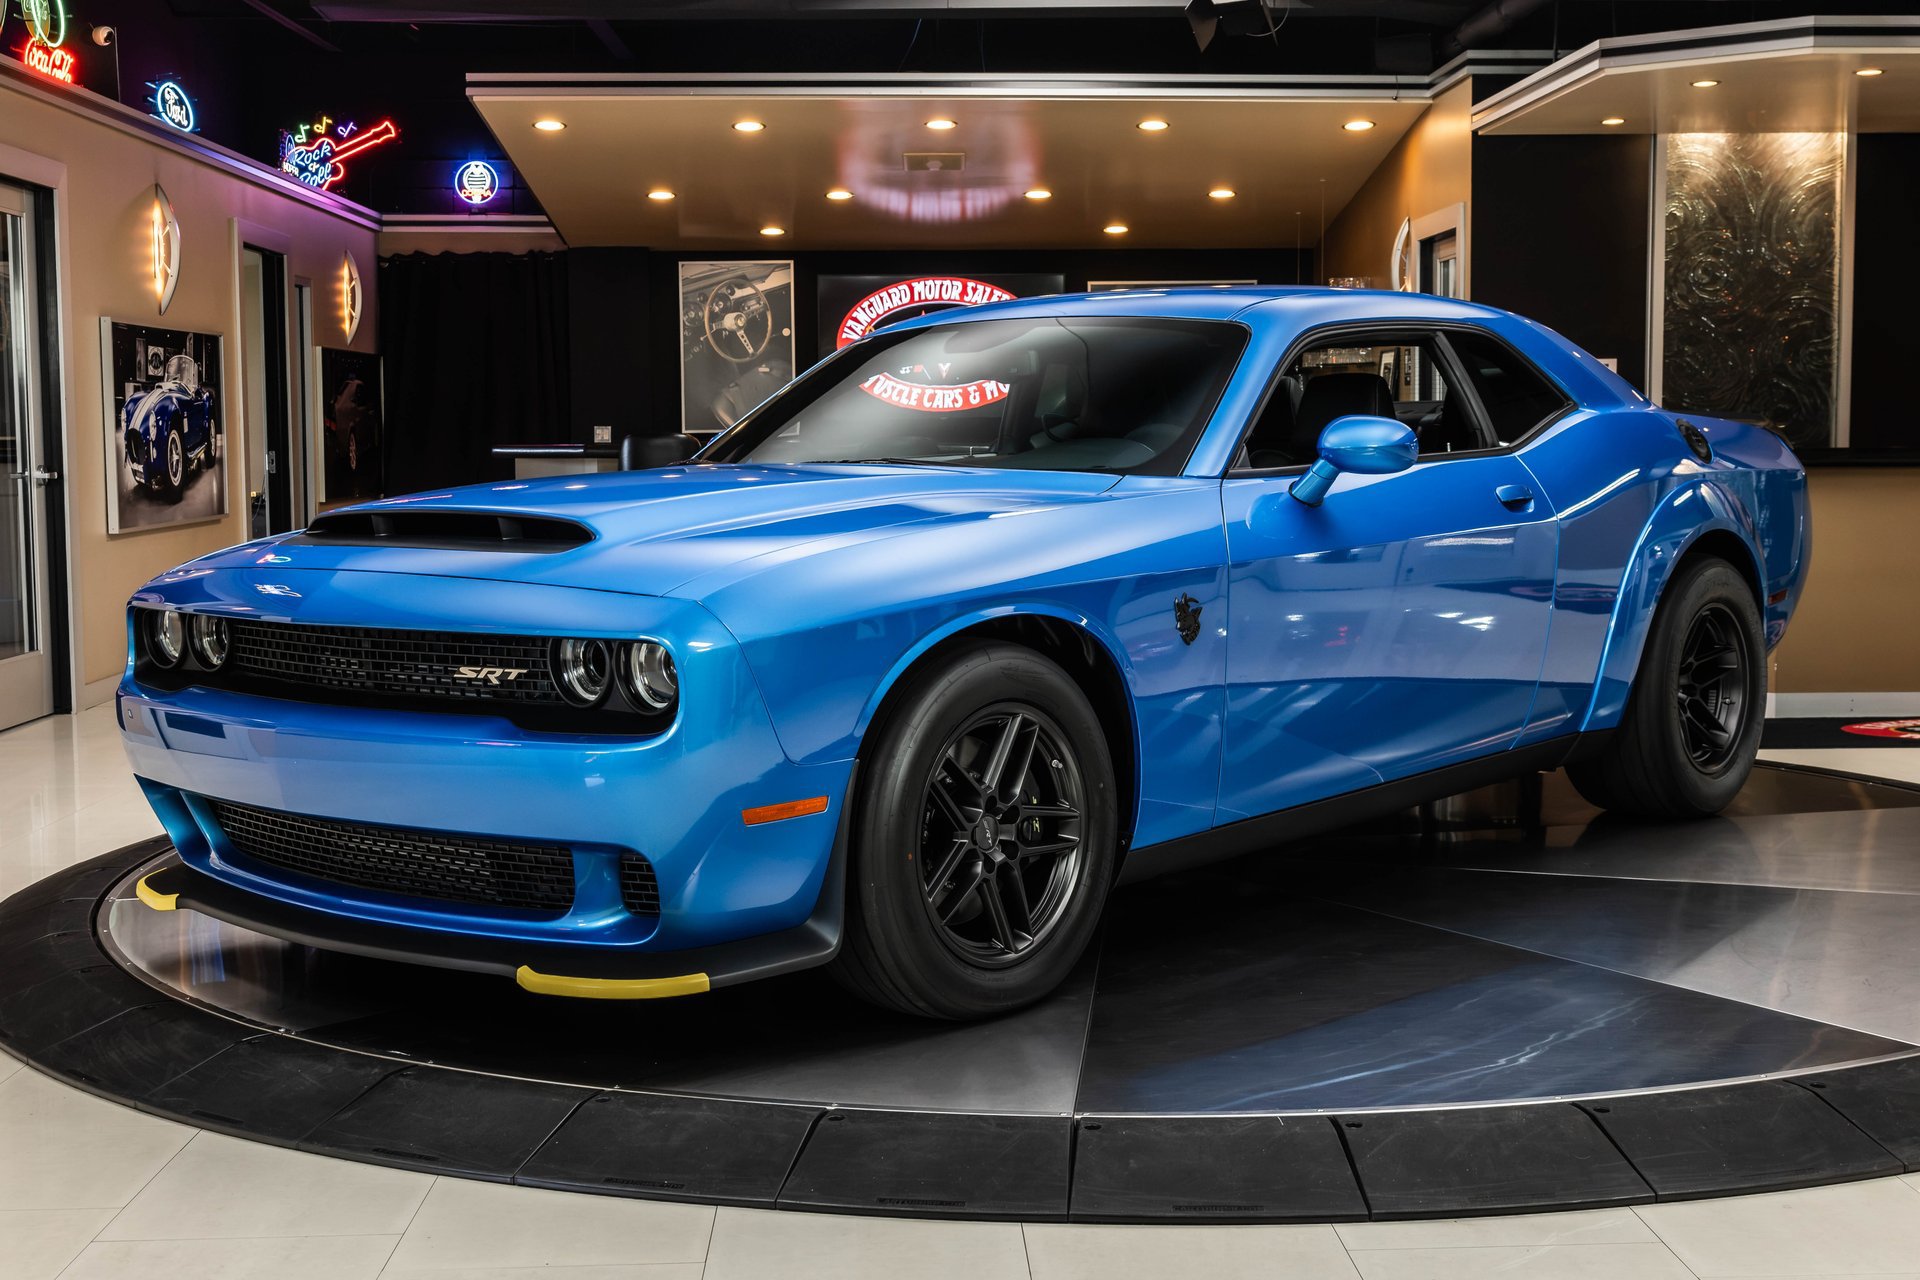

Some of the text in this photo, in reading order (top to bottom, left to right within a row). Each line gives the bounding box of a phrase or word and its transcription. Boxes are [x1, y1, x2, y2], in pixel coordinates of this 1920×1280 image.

[164, 87, 188, 126] Ford
[294, 140, 331, 166] Rock
[300, 162, 332, 187] Roll
[841, 283, 911, 340] VANGUARD
[911, 279, 963, 301] MOTOR
[922, 388, 963, 409] CARS
[967, 385, 980, 405] &
[453, 666, 528, 685] SRT
